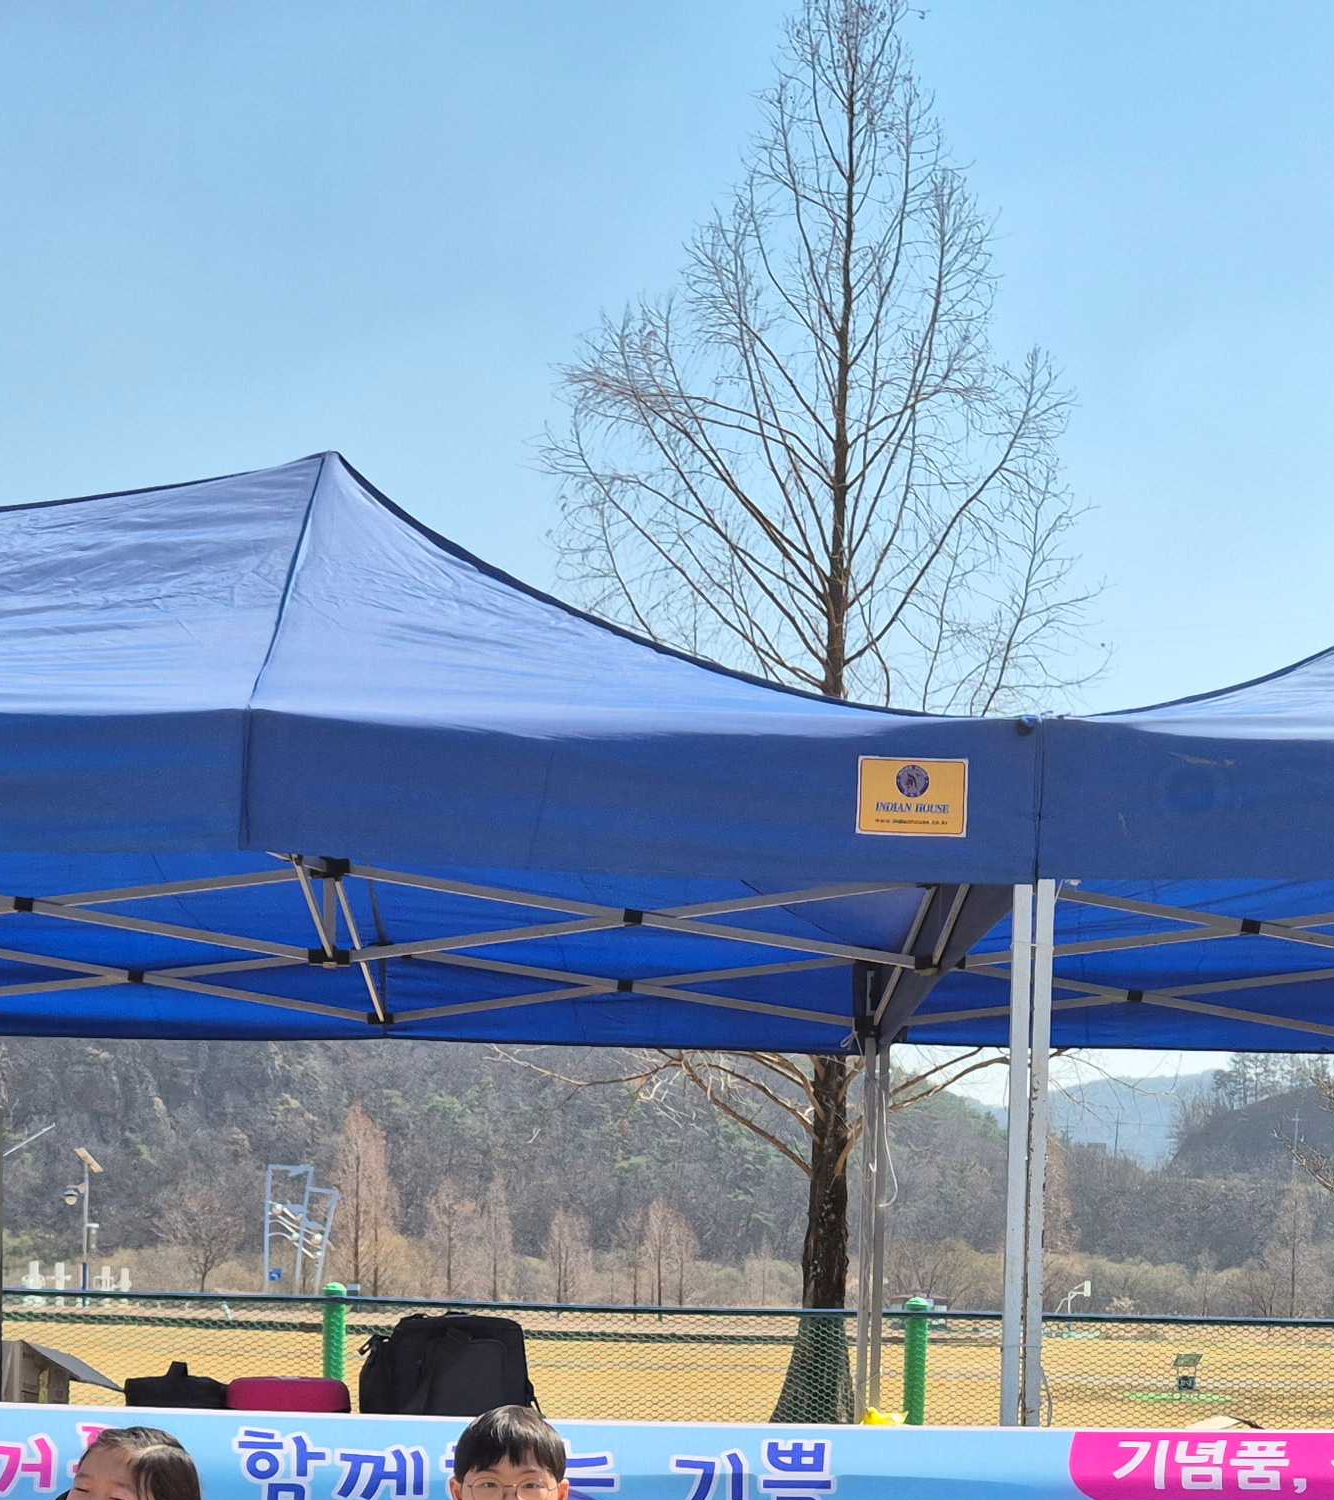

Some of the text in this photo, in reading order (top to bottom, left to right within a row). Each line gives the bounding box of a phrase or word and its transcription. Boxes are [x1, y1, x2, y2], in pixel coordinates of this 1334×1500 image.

[875, 801, 950, 814] INDIAN HOUSE
[1113, 1438, 1308, 1494] 기념품,
